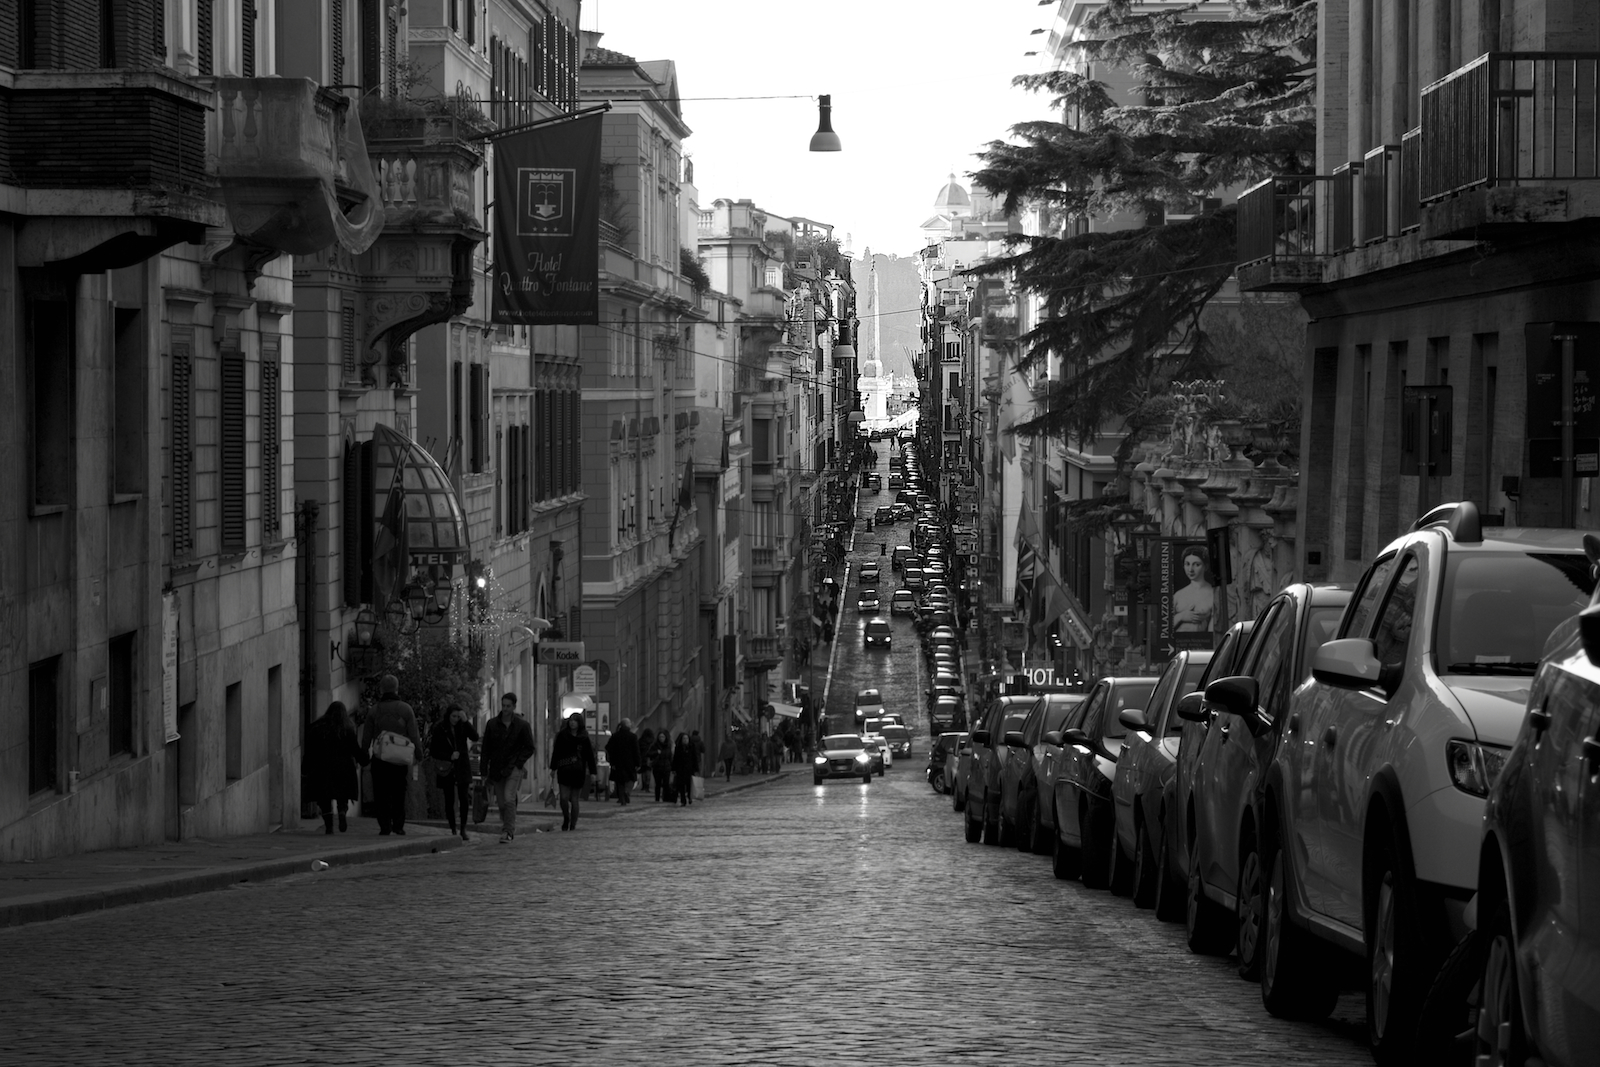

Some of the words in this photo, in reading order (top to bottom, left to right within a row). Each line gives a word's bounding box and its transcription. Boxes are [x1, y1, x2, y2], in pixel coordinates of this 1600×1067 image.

[527, 252, 562, 272] Hotel
[500, 271, 539, 296] Quattro
[542, 273, 593, 296] Fontane
[969, 503, 979, 629] RISTORATE
[1160, 541, 1169, 594] BARBERINI
[1160, 596, 1169, 639] PALAZZO
[556, 651, 580, 660] Kodak
